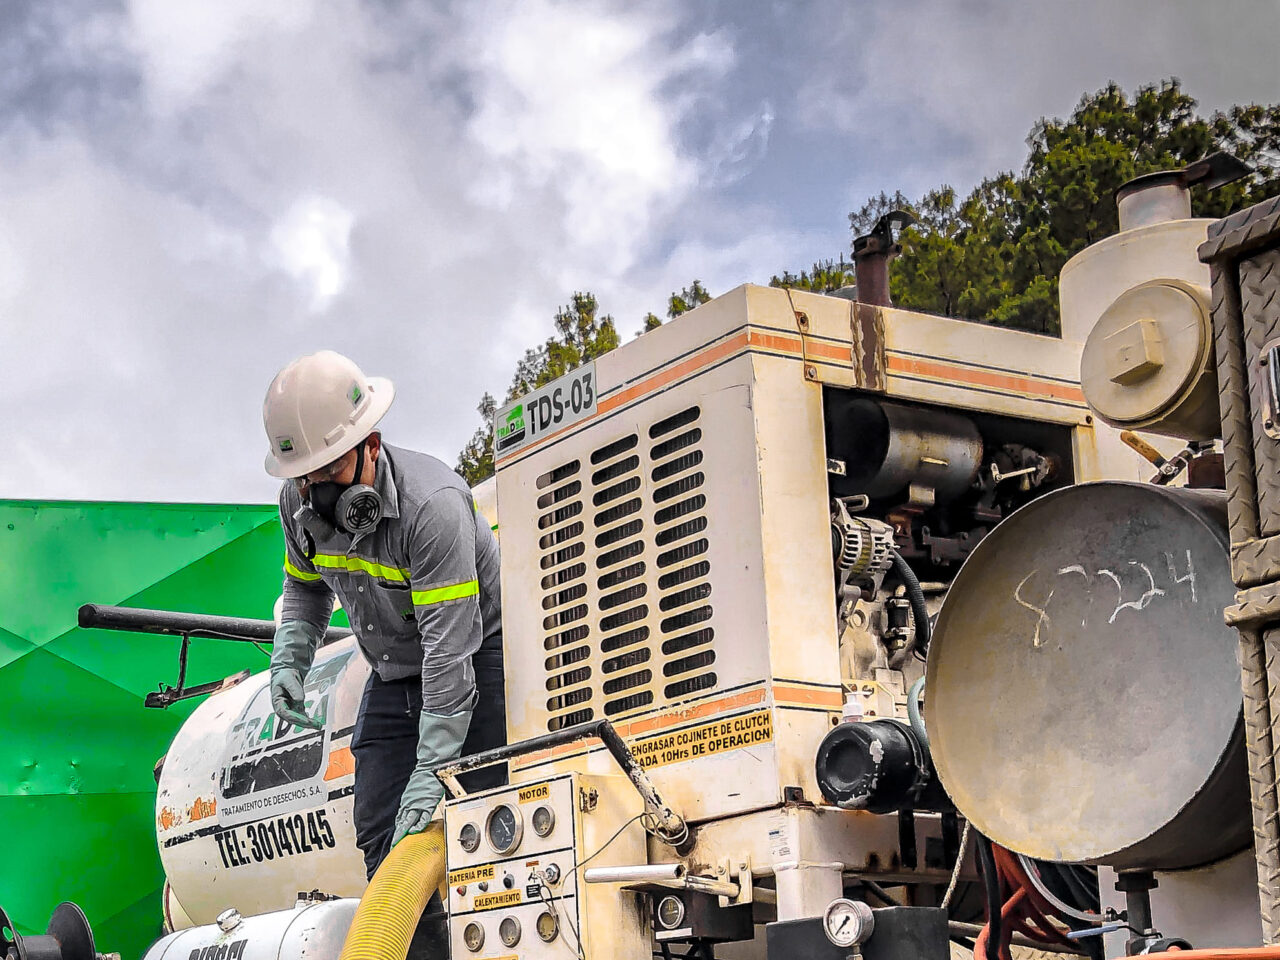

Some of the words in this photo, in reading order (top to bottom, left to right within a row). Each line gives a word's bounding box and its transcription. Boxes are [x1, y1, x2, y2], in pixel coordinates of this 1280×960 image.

[527, 372, 593, 435] TDS-03
[496, 416, 525, 439] TRADSA
[631, 737, 675, 756] ENGRASAR
[677, 726, 718, 744] COJINETE
[721, 722, 732, 735] DE
[734, 713, 770, 732] CLUTCH
[637, 755, 658, 768] ADA
[661, 748, 689, 763] 10Hrs
[692, 743, 705, 756] DE
[708, 728, 770, 752] OPERACION
[221, 799, 263, 817] TRATAMIENTO
[263, 796, 273, 807] DE
[273, 788, 308, 805] DESECHOS,
[309, 785, 322, 796] S.A.
[519, 786, 548, 801] MOTOR
[214, 828, 251, 869] TEL:
[247, 809, 336, 863] 30141245
[449, 871, 476, 884] BATERIA
[476, 867, 494, 879] PRE
[474, 892, 521, 908] CALENTAMIENTO
